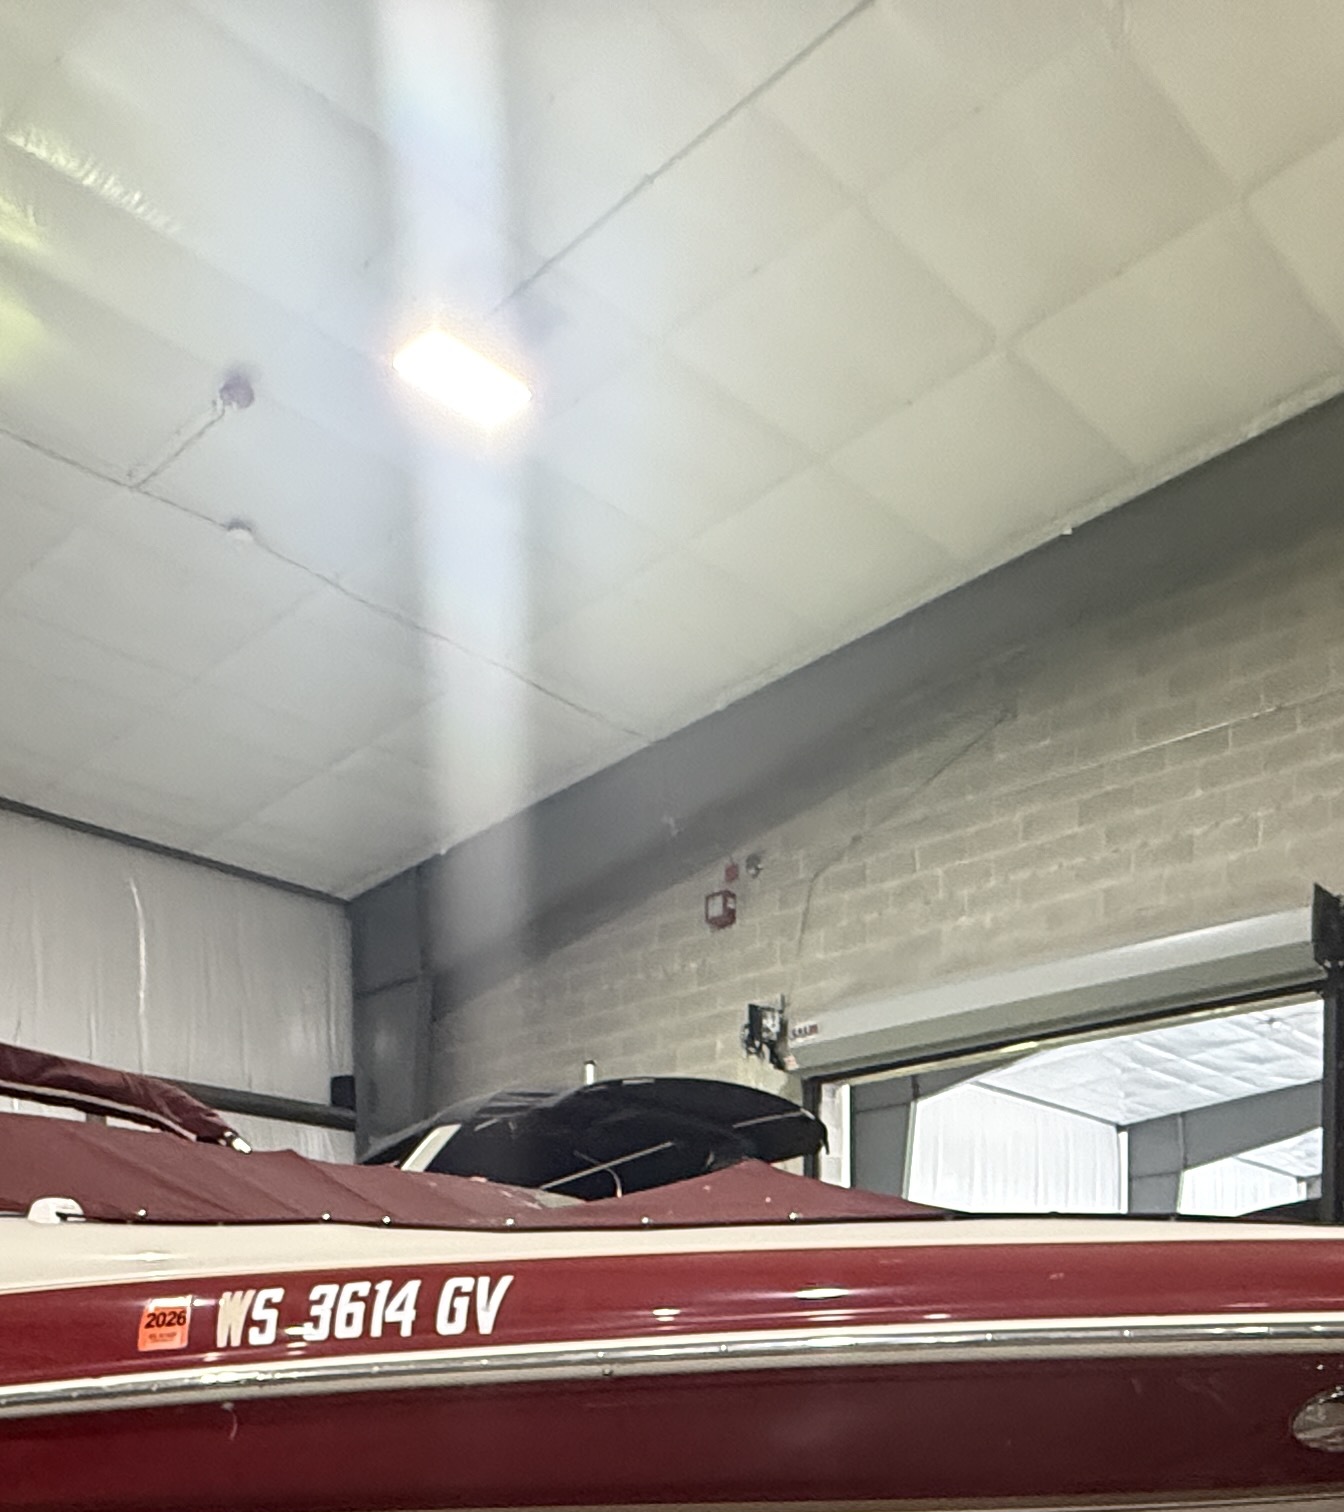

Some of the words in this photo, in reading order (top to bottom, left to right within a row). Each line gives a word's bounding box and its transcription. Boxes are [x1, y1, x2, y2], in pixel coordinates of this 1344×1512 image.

[144, 1310, 187, 1329] 2026
[216, 1287, 285, 1348] WS
[302, 1279, 422, 1341] 3614
[436, 1274, 514, 1336] GV
